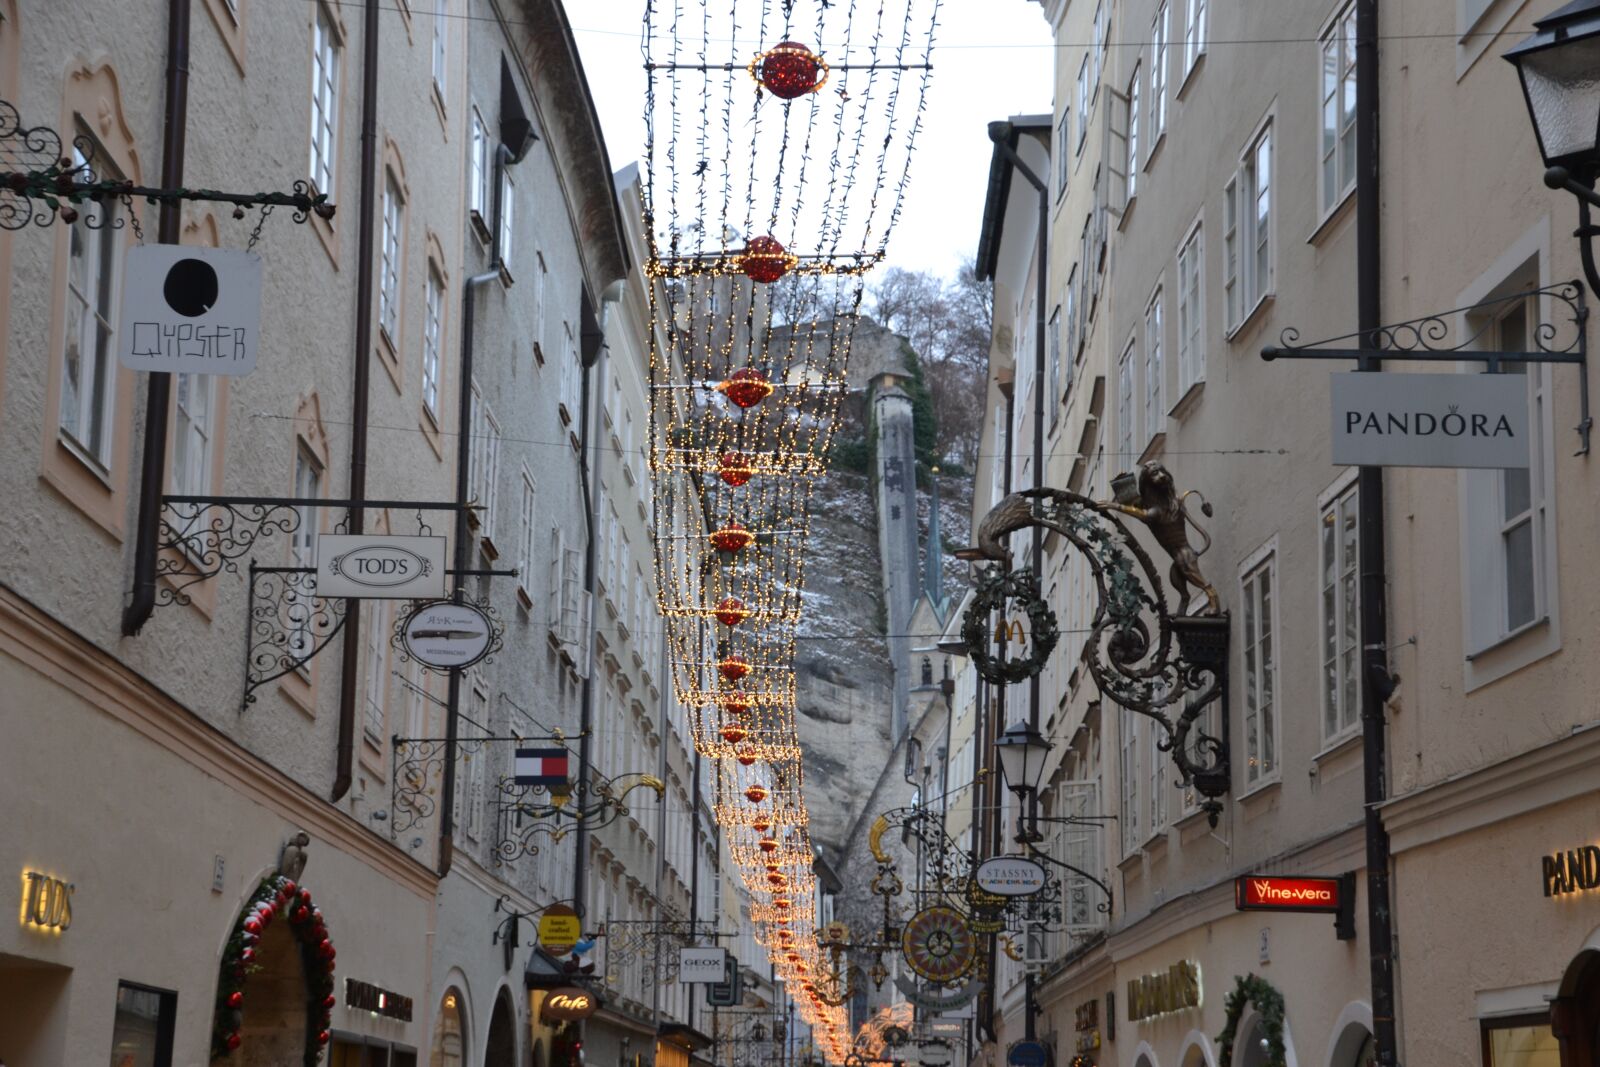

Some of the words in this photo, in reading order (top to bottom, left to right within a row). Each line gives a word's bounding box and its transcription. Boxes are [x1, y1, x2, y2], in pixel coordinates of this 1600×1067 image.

[132, 322, 245, 360] QYPSTER
[1346, 411, 1514, 437] PANDORA
[355, 558, 408, 575] TOD'S
[986, 869, 1034, 878] STASSNY
[550, 995, 588, 1010] Café
